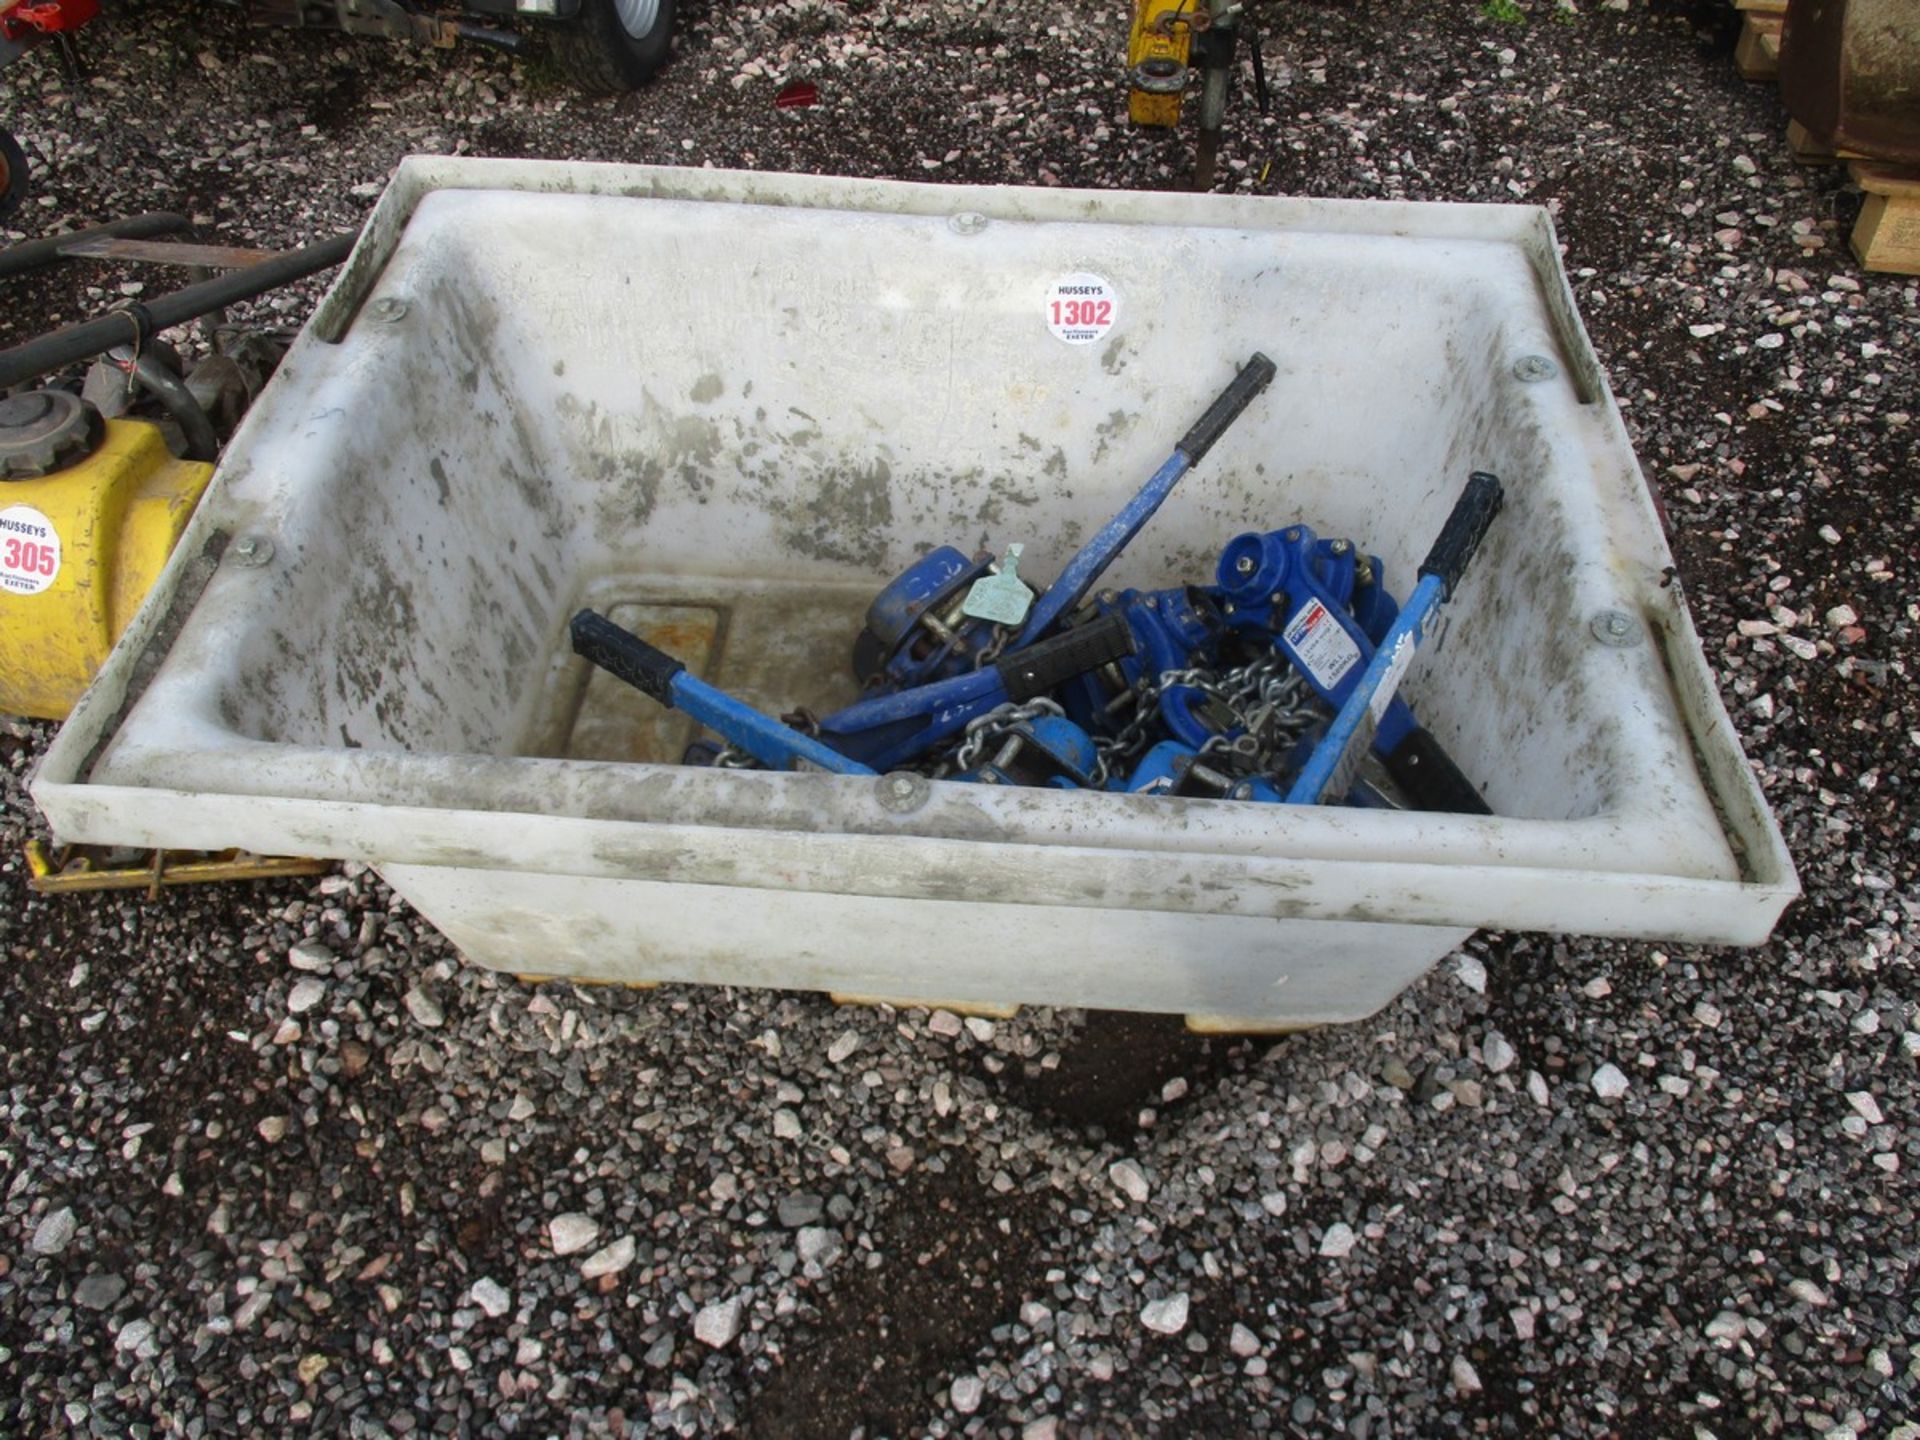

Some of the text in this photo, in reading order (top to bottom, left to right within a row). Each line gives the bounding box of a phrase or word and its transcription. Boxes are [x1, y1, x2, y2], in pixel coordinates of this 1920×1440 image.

[1058, 286, 1103, 295] HUSSEYS
[1051, 300, 1111, 325] 1302
[0, 518, 46, 538] HUSSEYS
[4, 538, 54, 576] 305
[5, 578, 36, 590] EXETER
